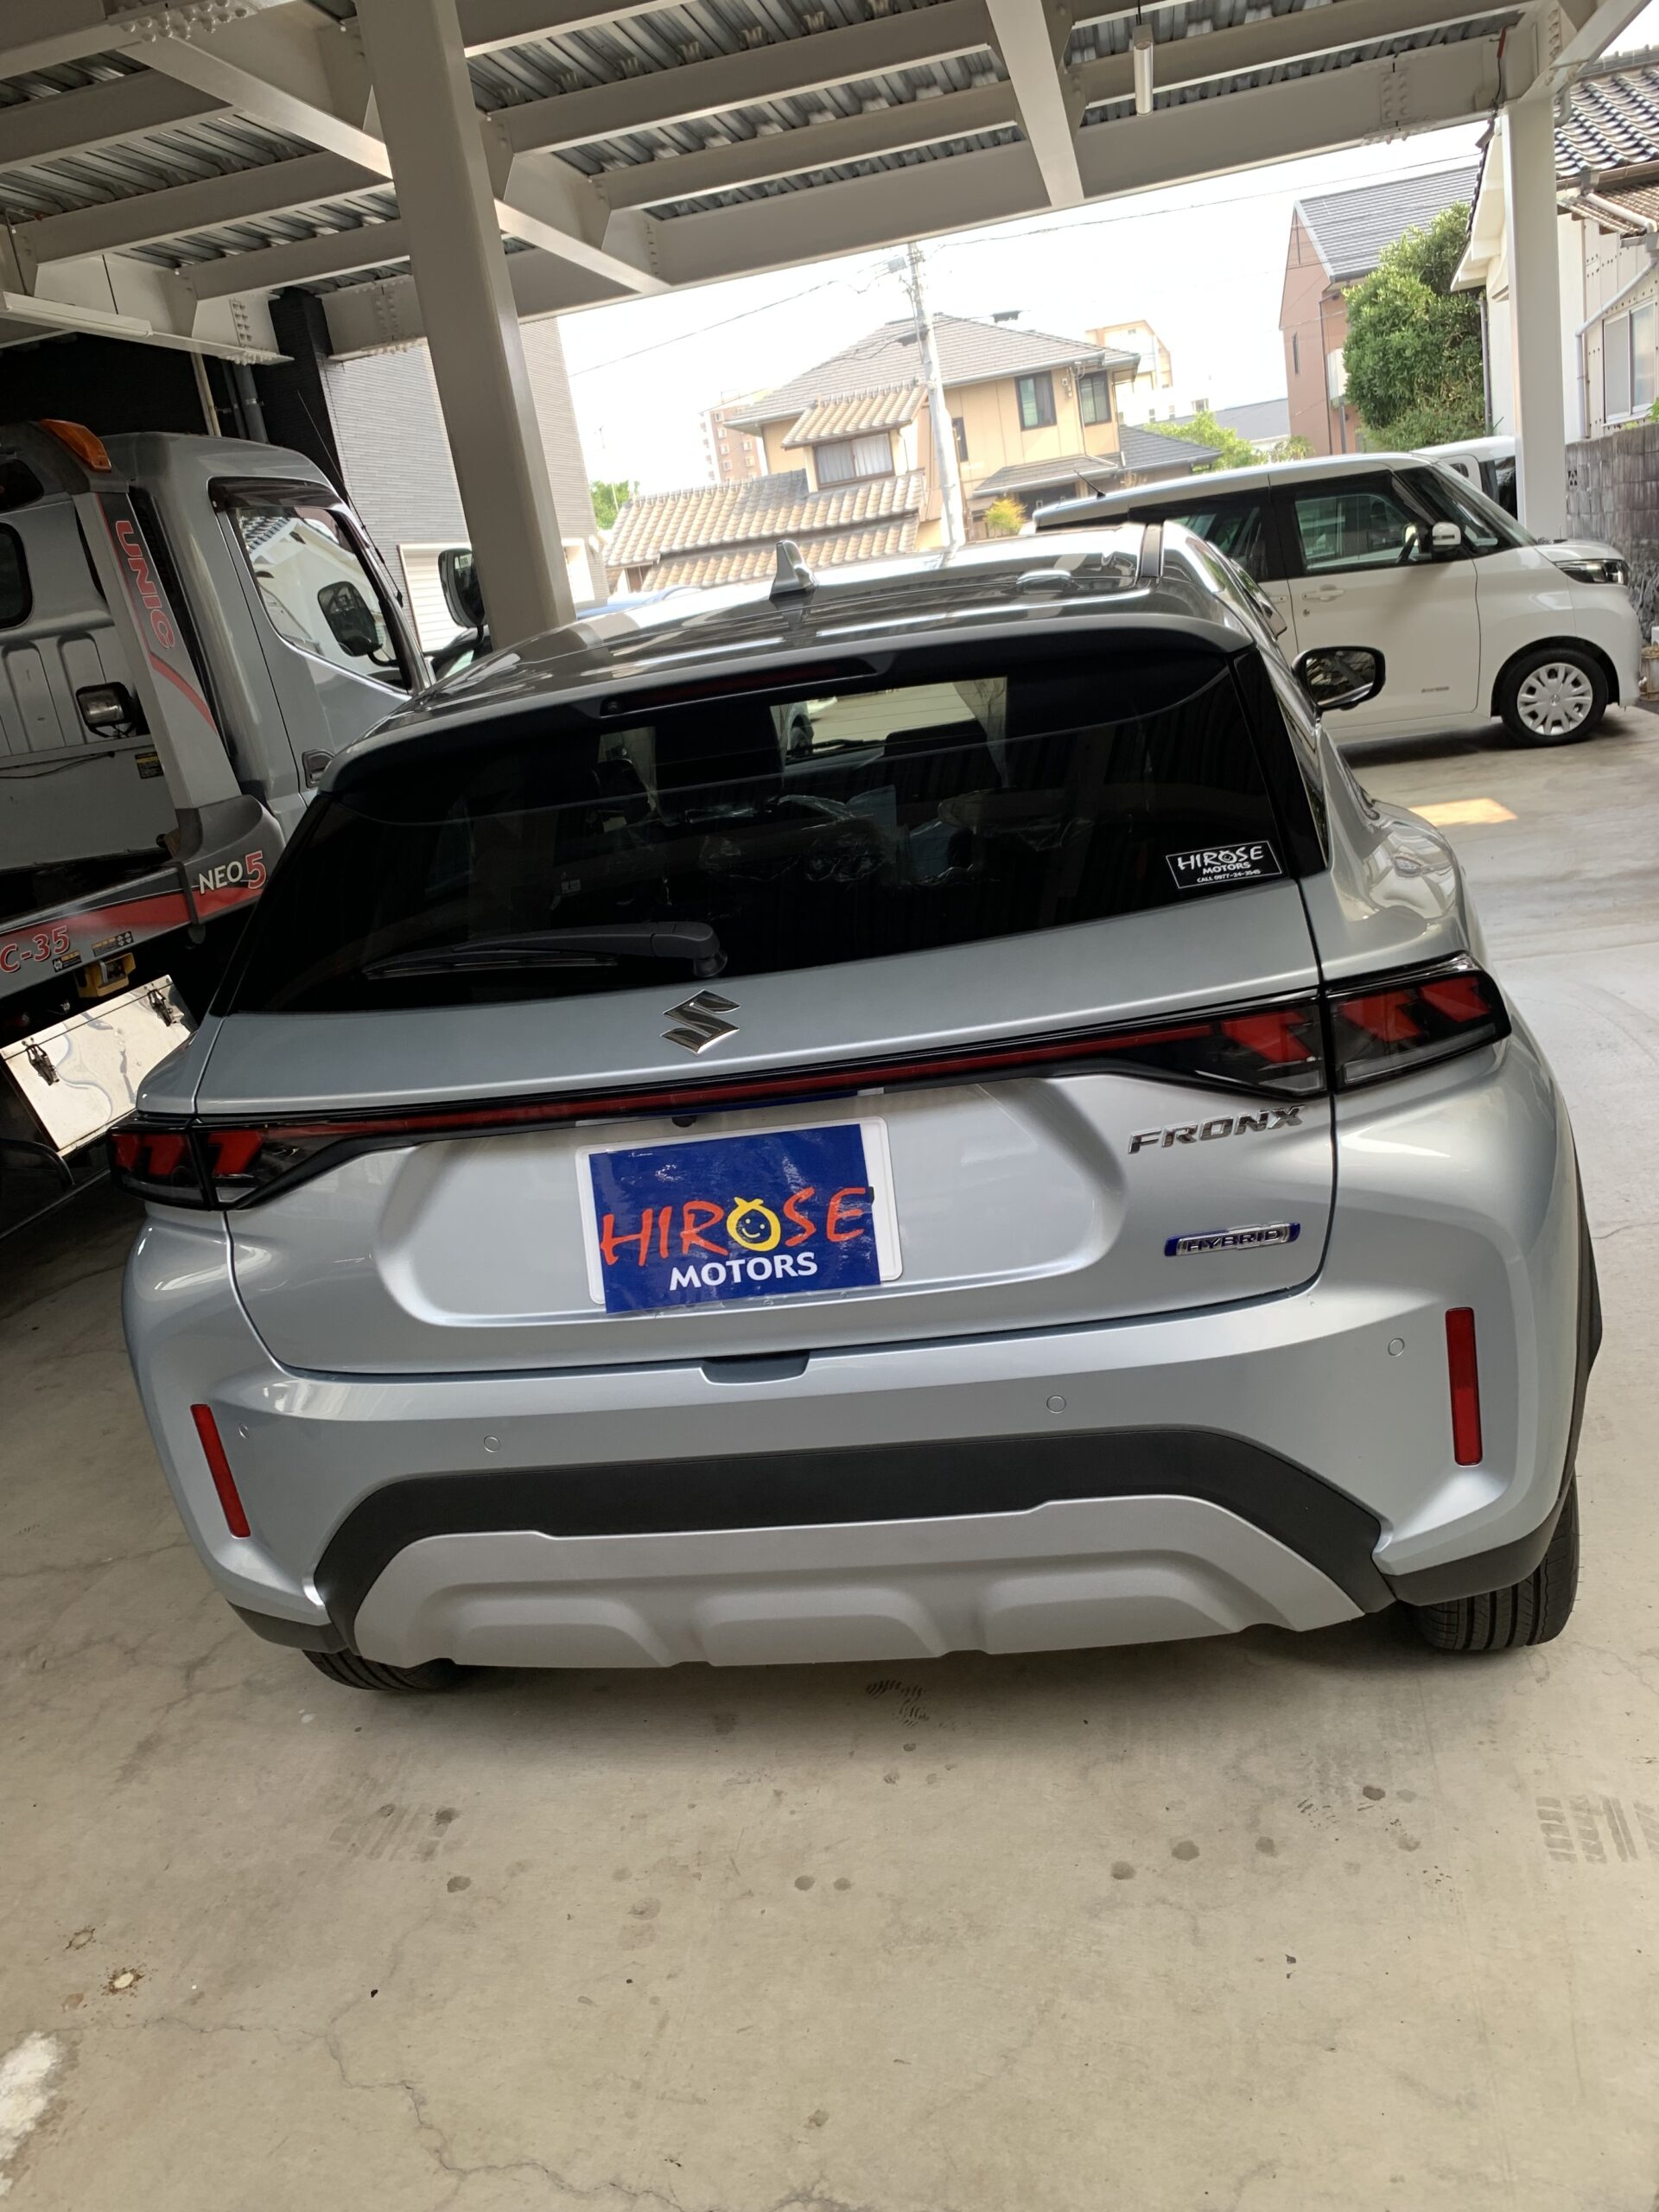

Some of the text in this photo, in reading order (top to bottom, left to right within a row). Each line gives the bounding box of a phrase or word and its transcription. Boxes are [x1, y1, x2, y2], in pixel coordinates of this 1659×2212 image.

[115, 520, 175, 648] UNIC
[1177, 845, 1264, 870] HIROSE
[1202, 861, 1251, 874] MOTORS
[1128, 1104, 1306, 1154] FRONX
[601, 1186, 867, 1267] HIROSE
[1186, 1230, 1282, 1253] HYBRID
[669, 1251, 818, 1292] MOTORS
